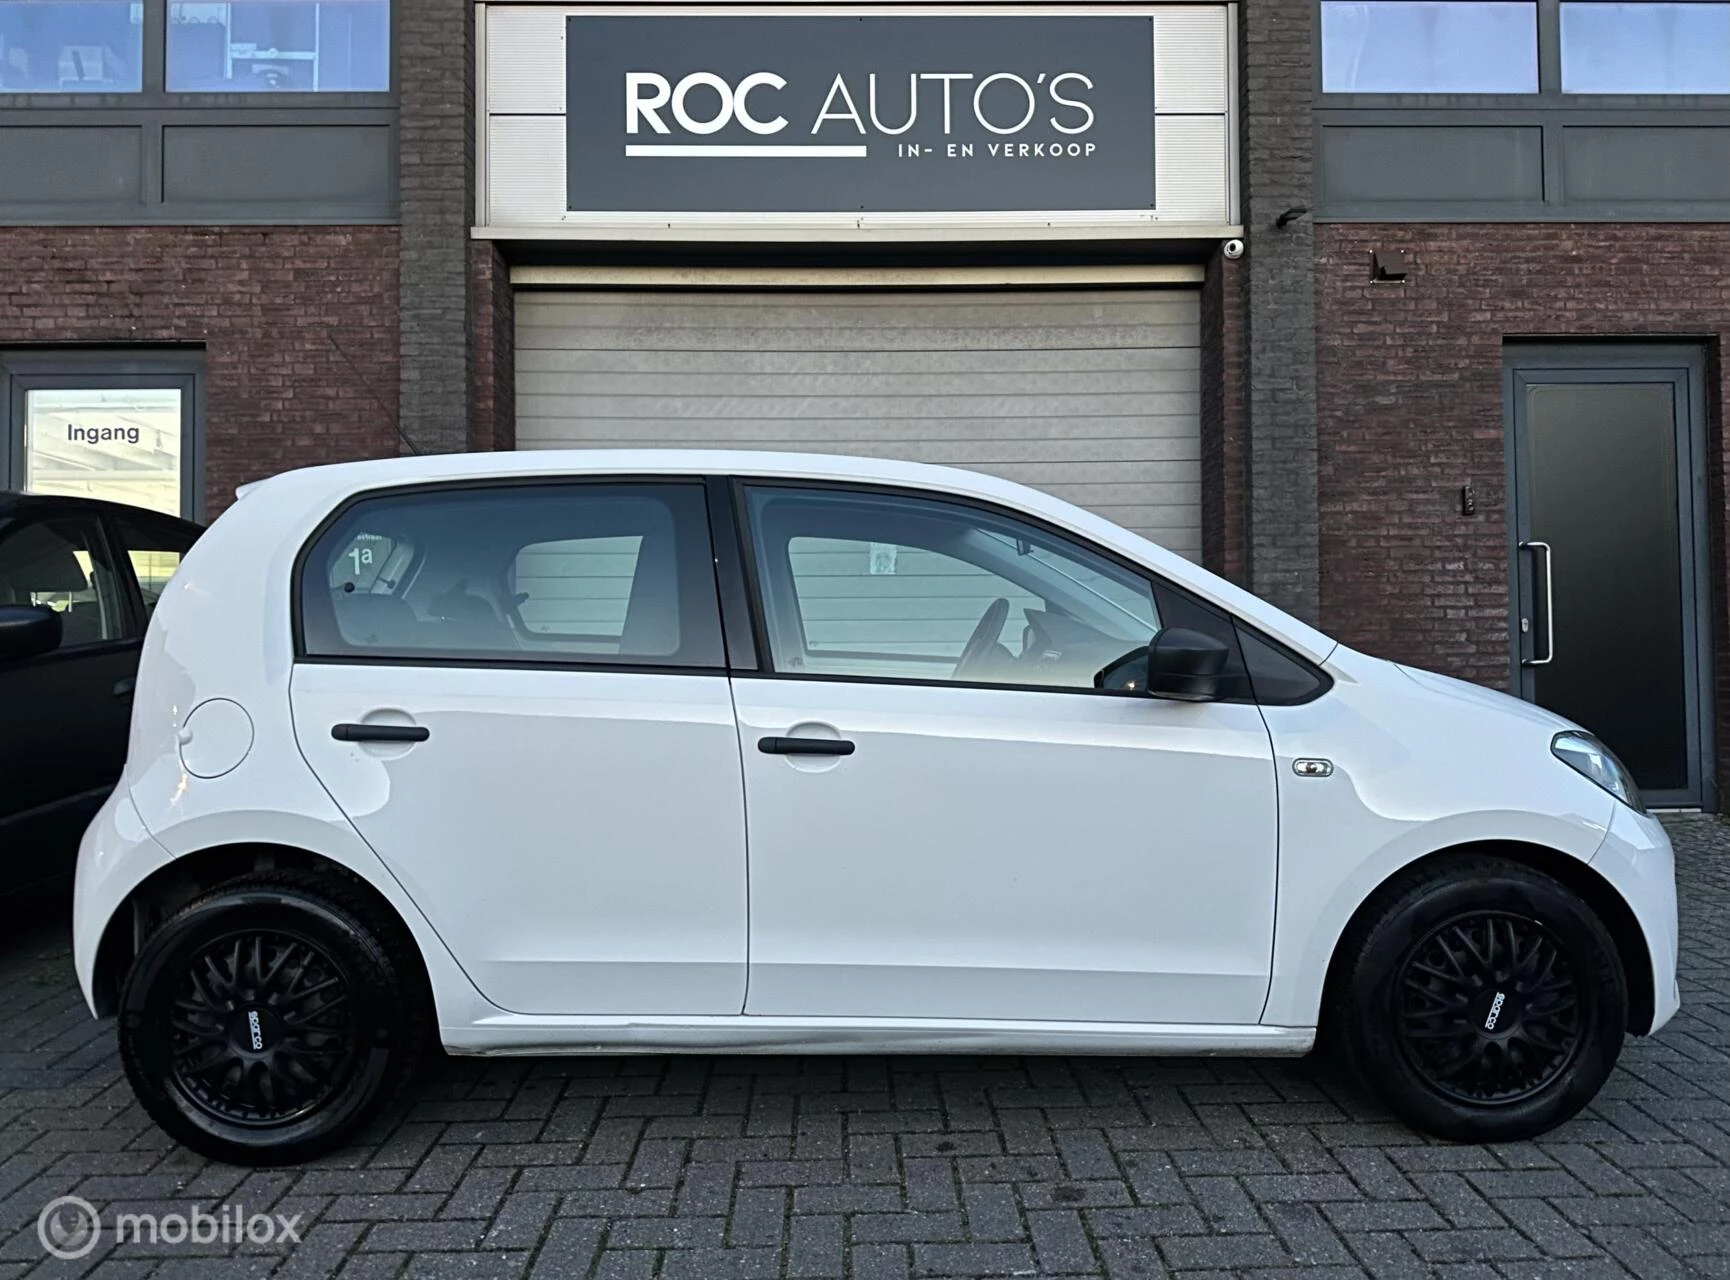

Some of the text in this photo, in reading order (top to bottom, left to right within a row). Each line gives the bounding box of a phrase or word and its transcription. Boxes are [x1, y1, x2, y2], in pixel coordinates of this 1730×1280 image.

[626, 72, 1095, 135] ROC AUTO'S
[898, 143, 1096, 157] IN- EN VERKOOP
[67, 424, 140, 444] Ingang
